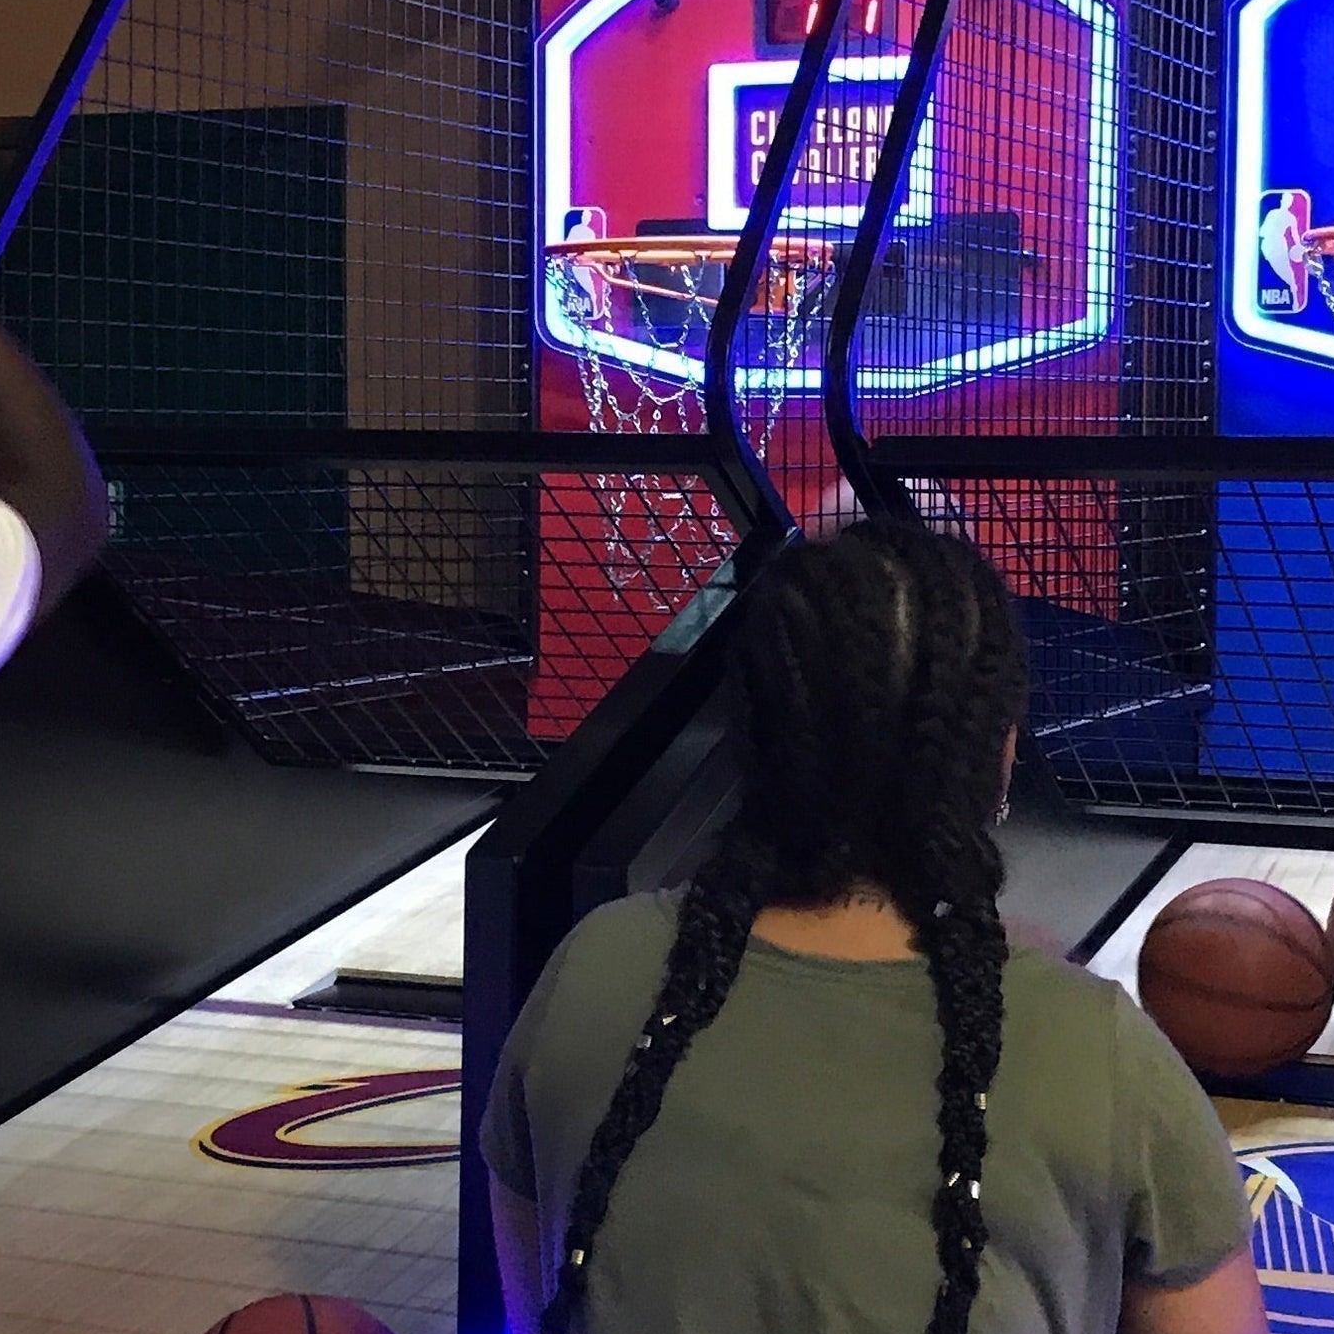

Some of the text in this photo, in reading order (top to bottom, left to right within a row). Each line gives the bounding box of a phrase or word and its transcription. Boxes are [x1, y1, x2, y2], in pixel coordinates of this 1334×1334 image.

[750, 104, 896, 146] CLELAN
[751, 145, 881, 186] CALIER
[1261, 288, 1291, 305] NBA
